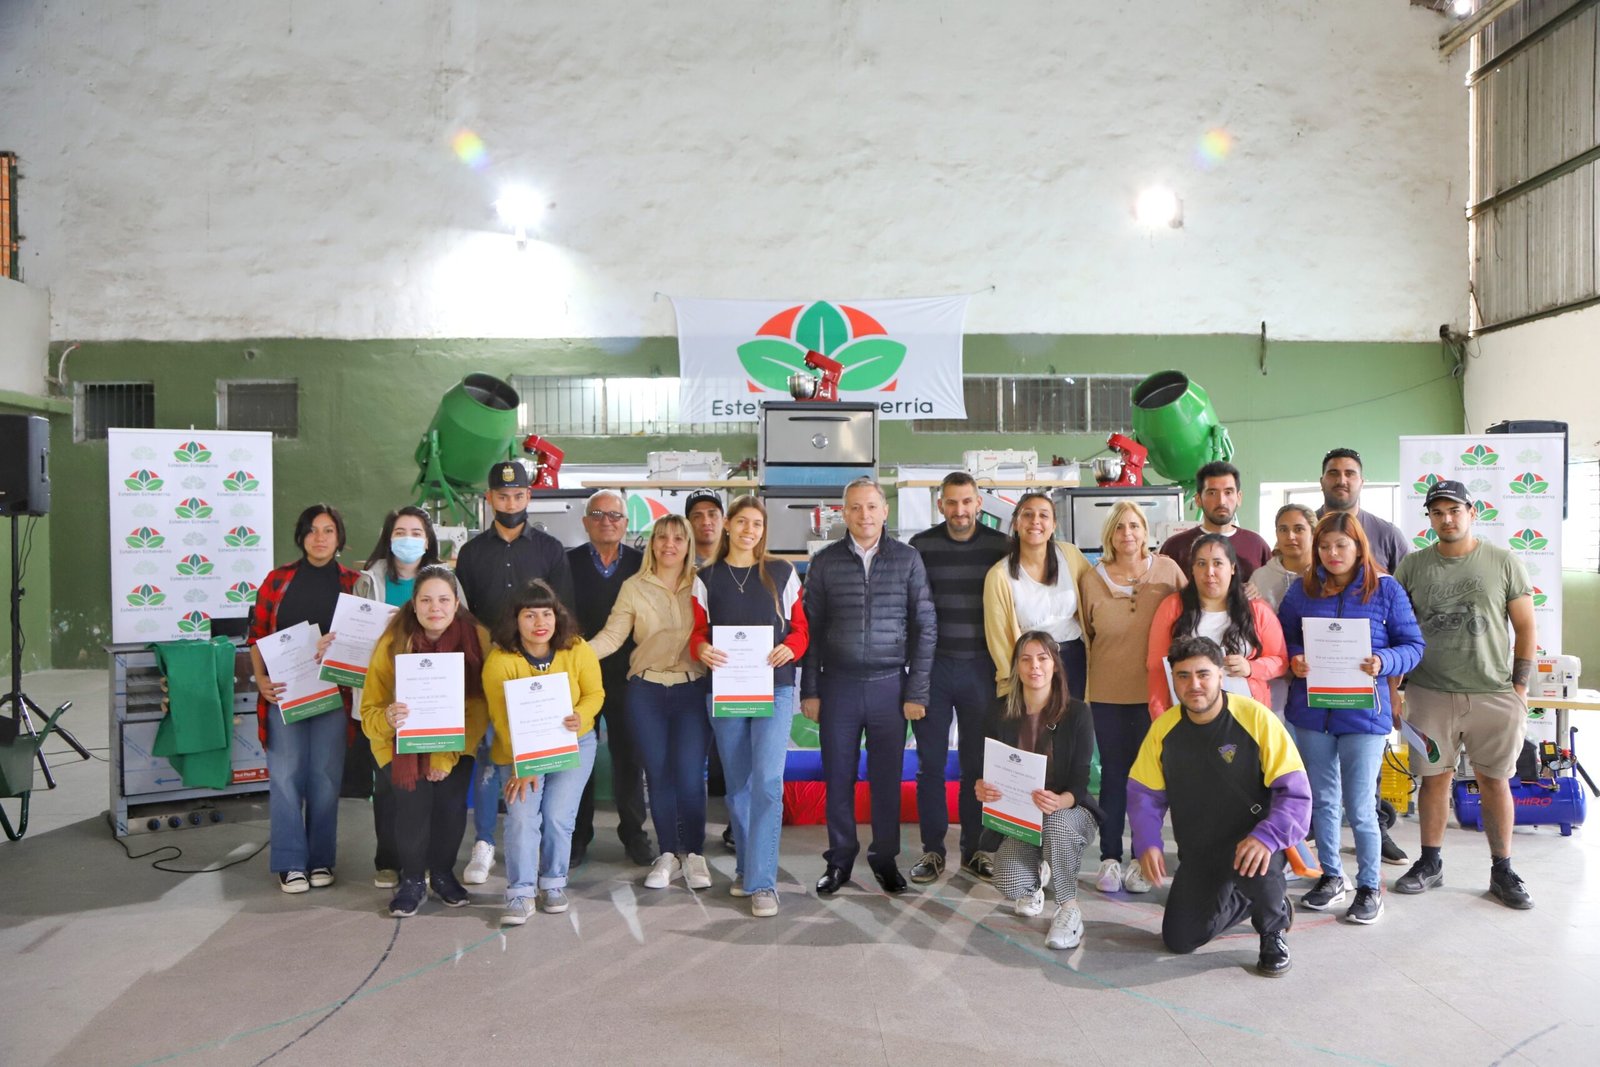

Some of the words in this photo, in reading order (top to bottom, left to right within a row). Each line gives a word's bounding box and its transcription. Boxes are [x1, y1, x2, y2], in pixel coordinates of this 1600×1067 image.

[711, 399, 761, 416] Este
[880, 397, 934, 413] erría
[1513, 797, 1553, 807] HIRO
